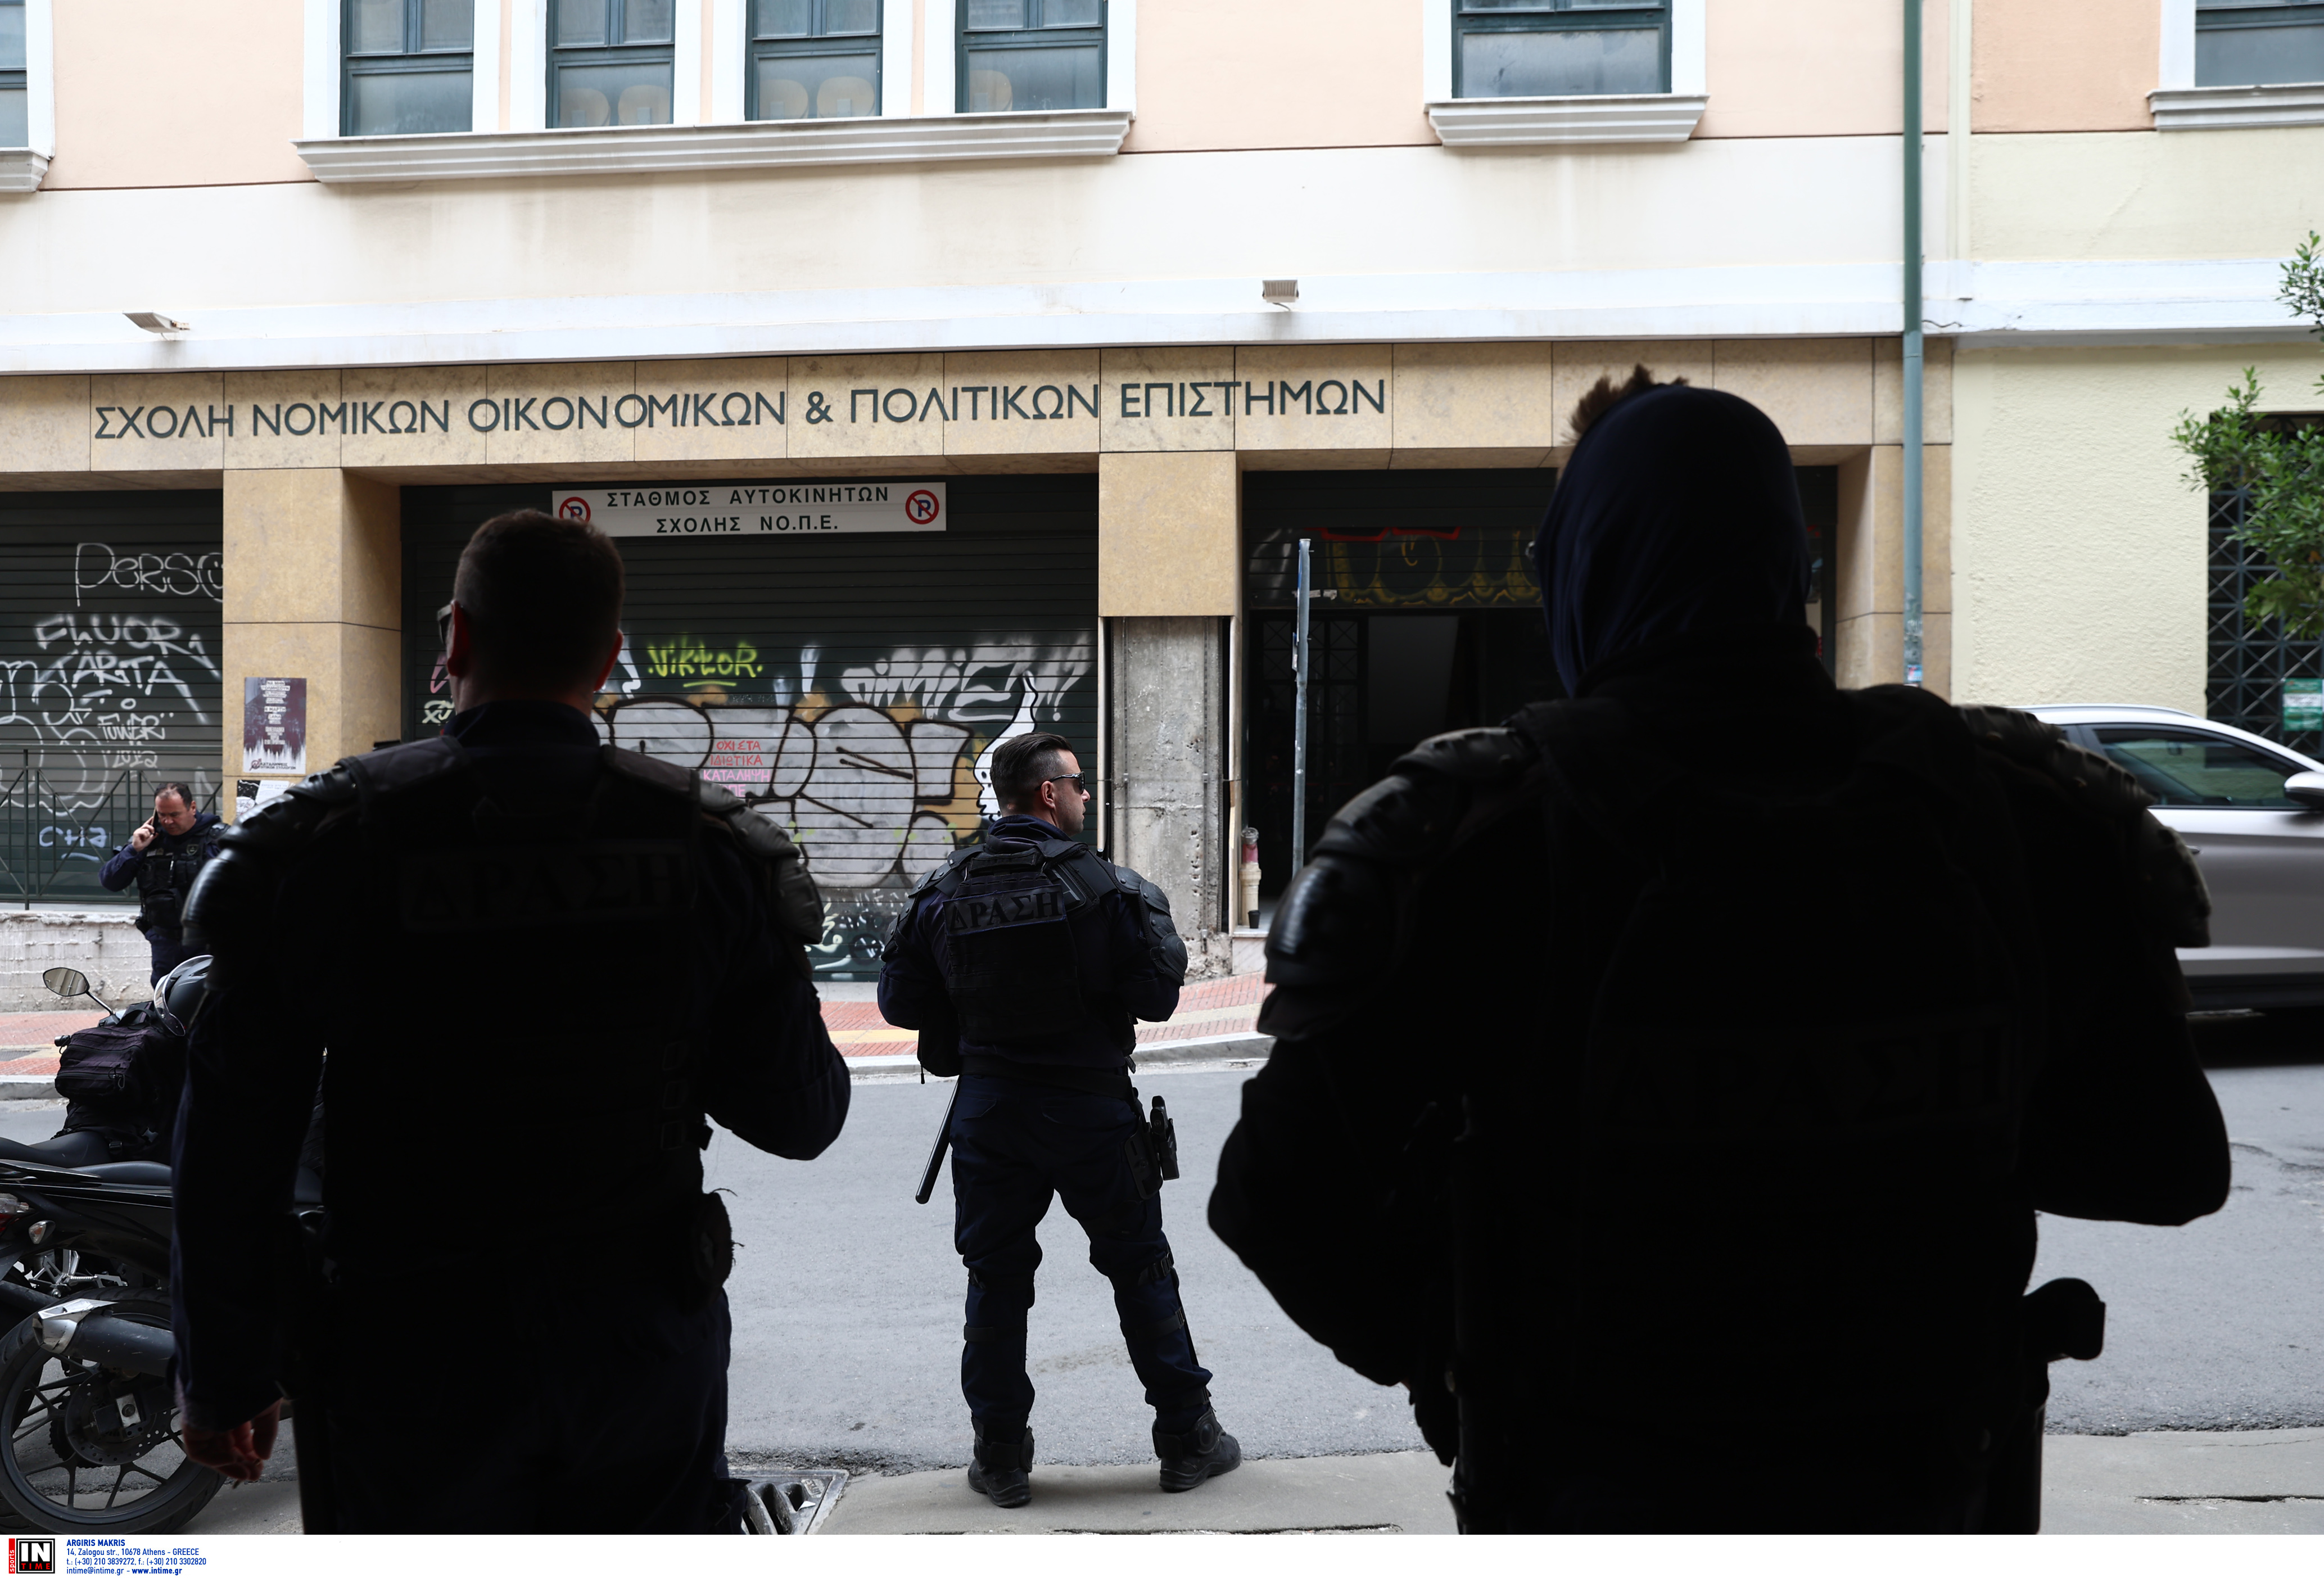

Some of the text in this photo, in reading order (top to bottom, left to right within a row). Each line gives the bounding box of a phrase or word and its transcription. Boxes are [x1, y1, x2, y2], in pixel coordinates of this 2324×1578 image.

[95, 379, 1384, 438] ΣΧΟΛΗ ΝΟΜΙΚΩΝ ΟΙΚΟΝΟΜΙΚΩΝ & ΠΟΛΙΤΙΚΩΝ ΕΠΙΣΤΗΜΩΝ
[607, 486, 889, 508] ΣΤΑΘΜΟΣ ΑΥΤΟΚΙΝΗΤΩΝ
[656, 514, 838, 533] ΣΧΟΛΗΣ ΝΟ.Π.Ε.
[716, 740, 735, 750] ΟΧΙ
[710, 754, 763, 766] ΙΔΙΩΤΙΚΑ
[703, 769, 771, 783] ΚΑΤΑΛΗΨΗ
[949, 891, 1062, 932] ΔΡΑΣΗ
